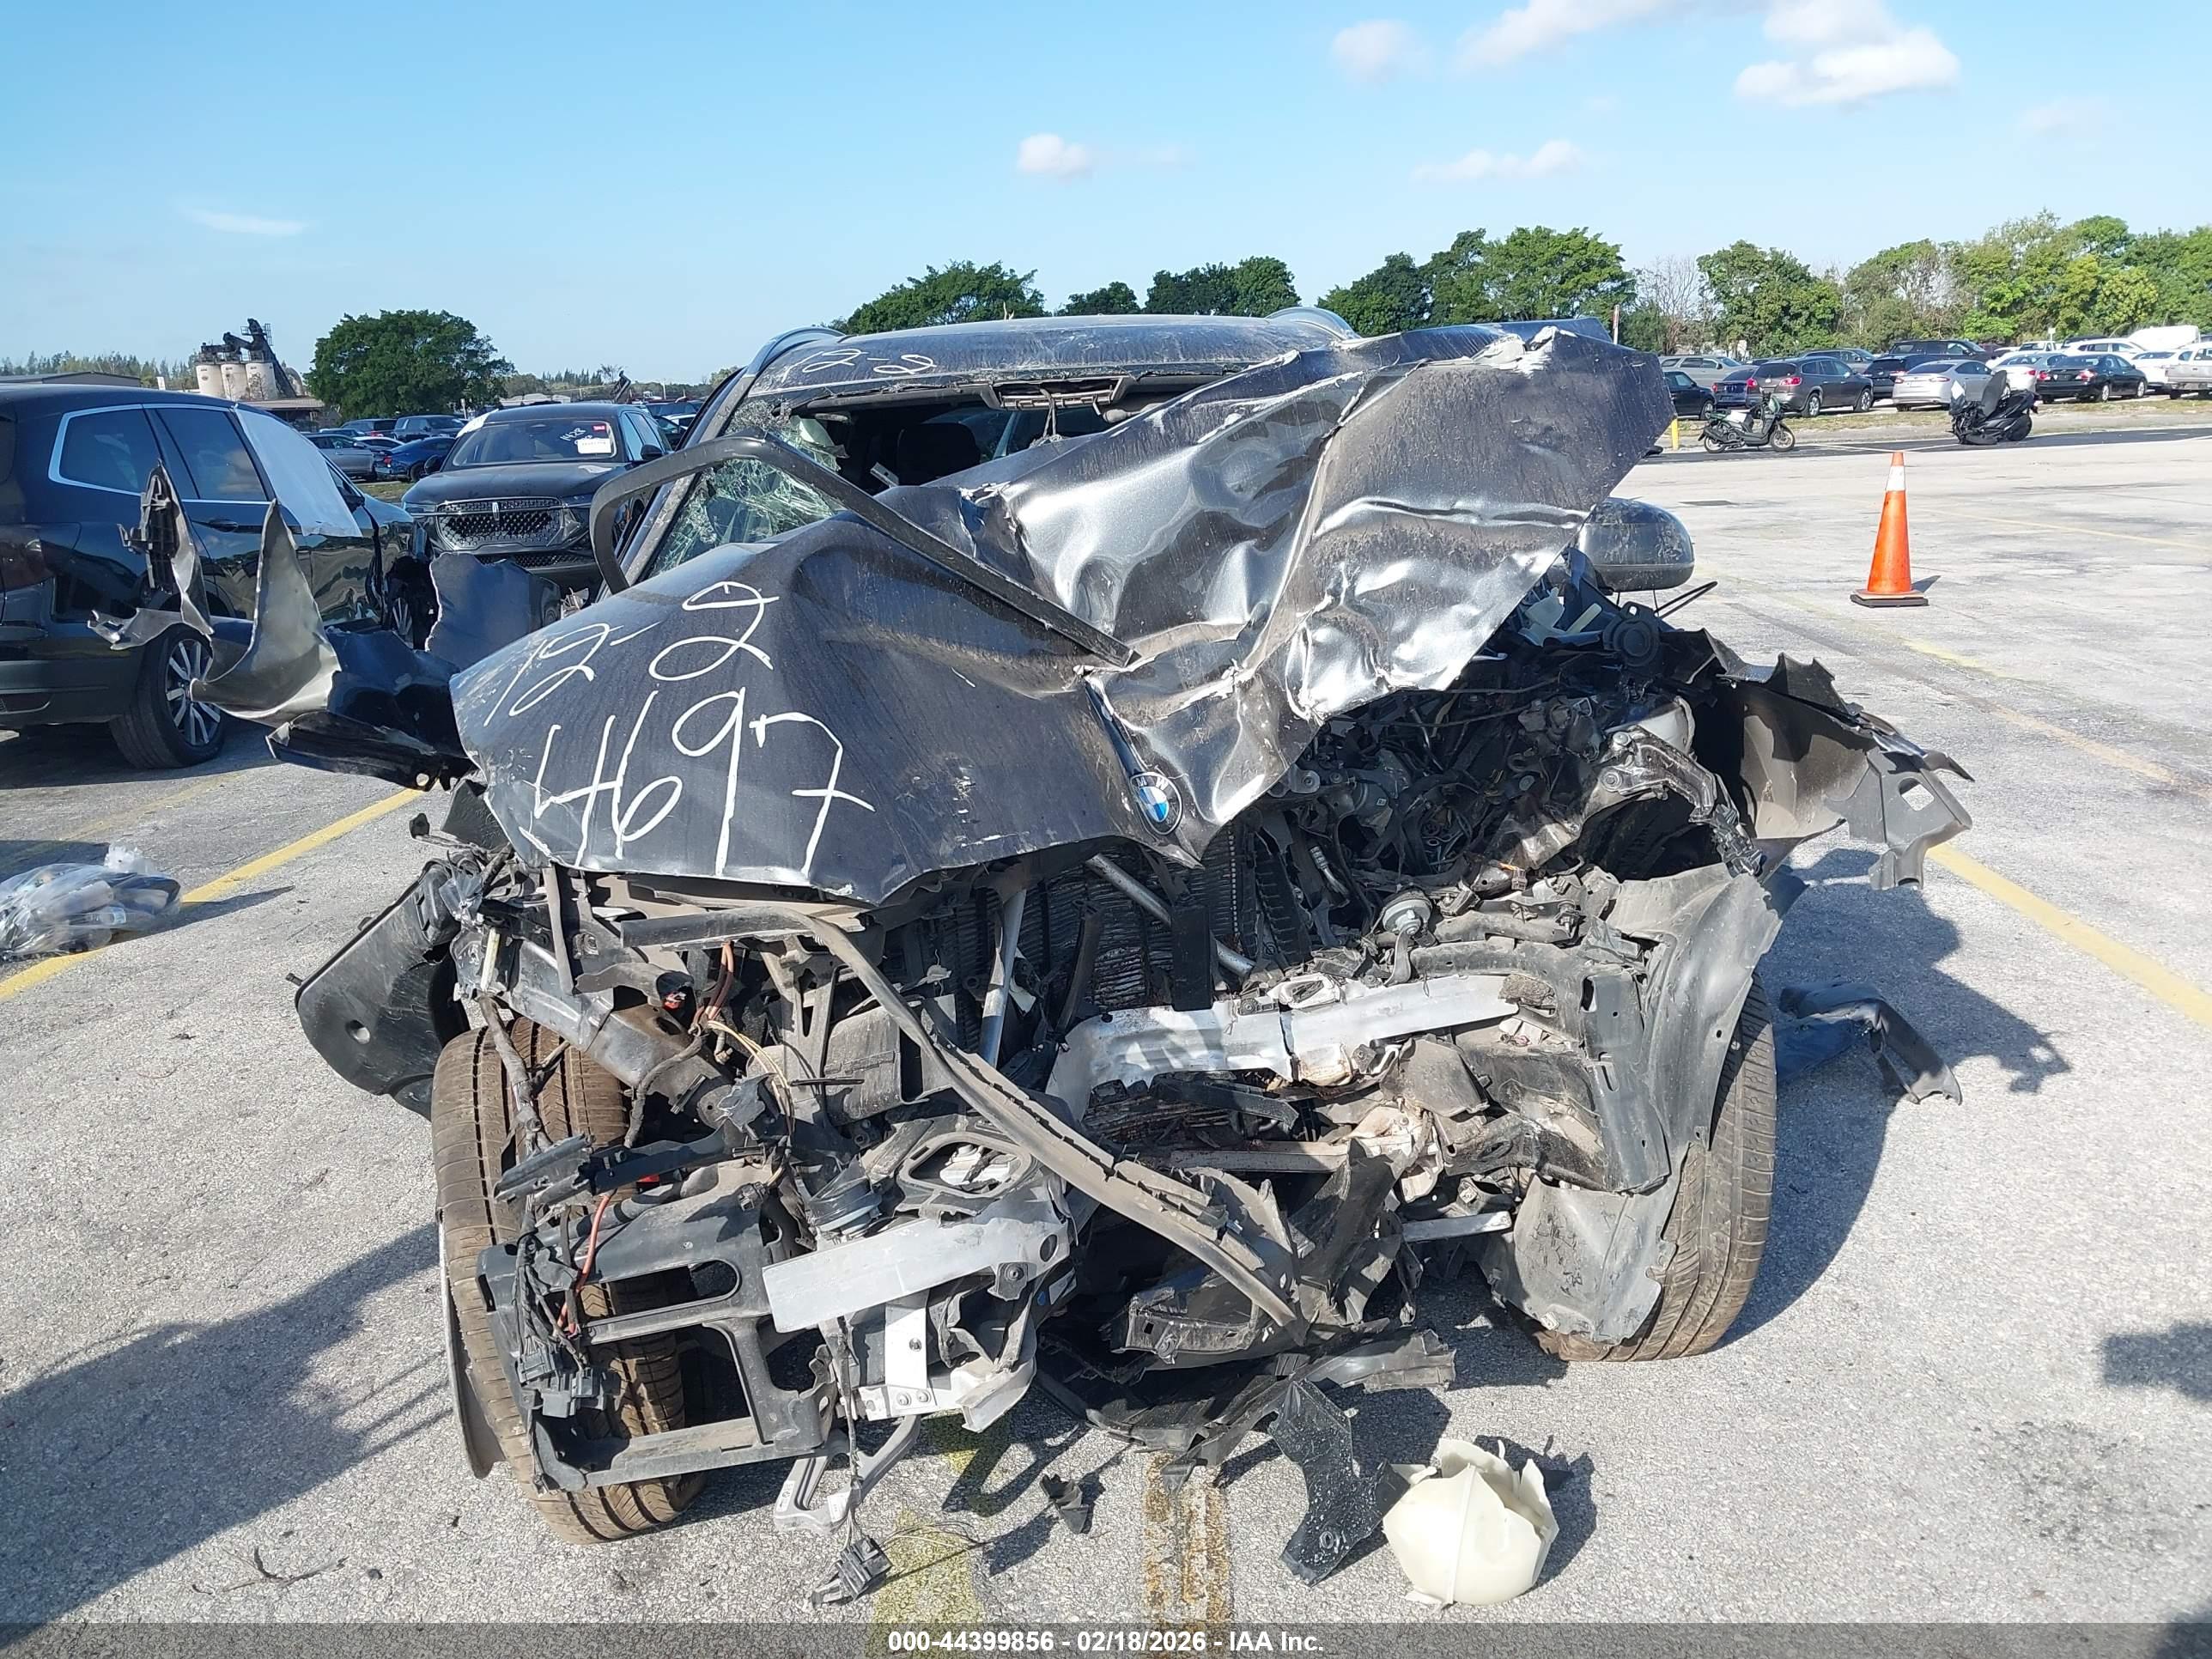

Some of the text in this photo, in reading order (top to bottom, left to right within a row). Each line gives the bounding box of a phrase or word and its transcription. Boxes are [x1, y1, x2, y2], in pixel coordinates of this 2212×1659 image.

[781, 348, 938, 383] 12-2
[483, 580, 781, 726] 12-2
[520, 686, 876, 878] 4697
